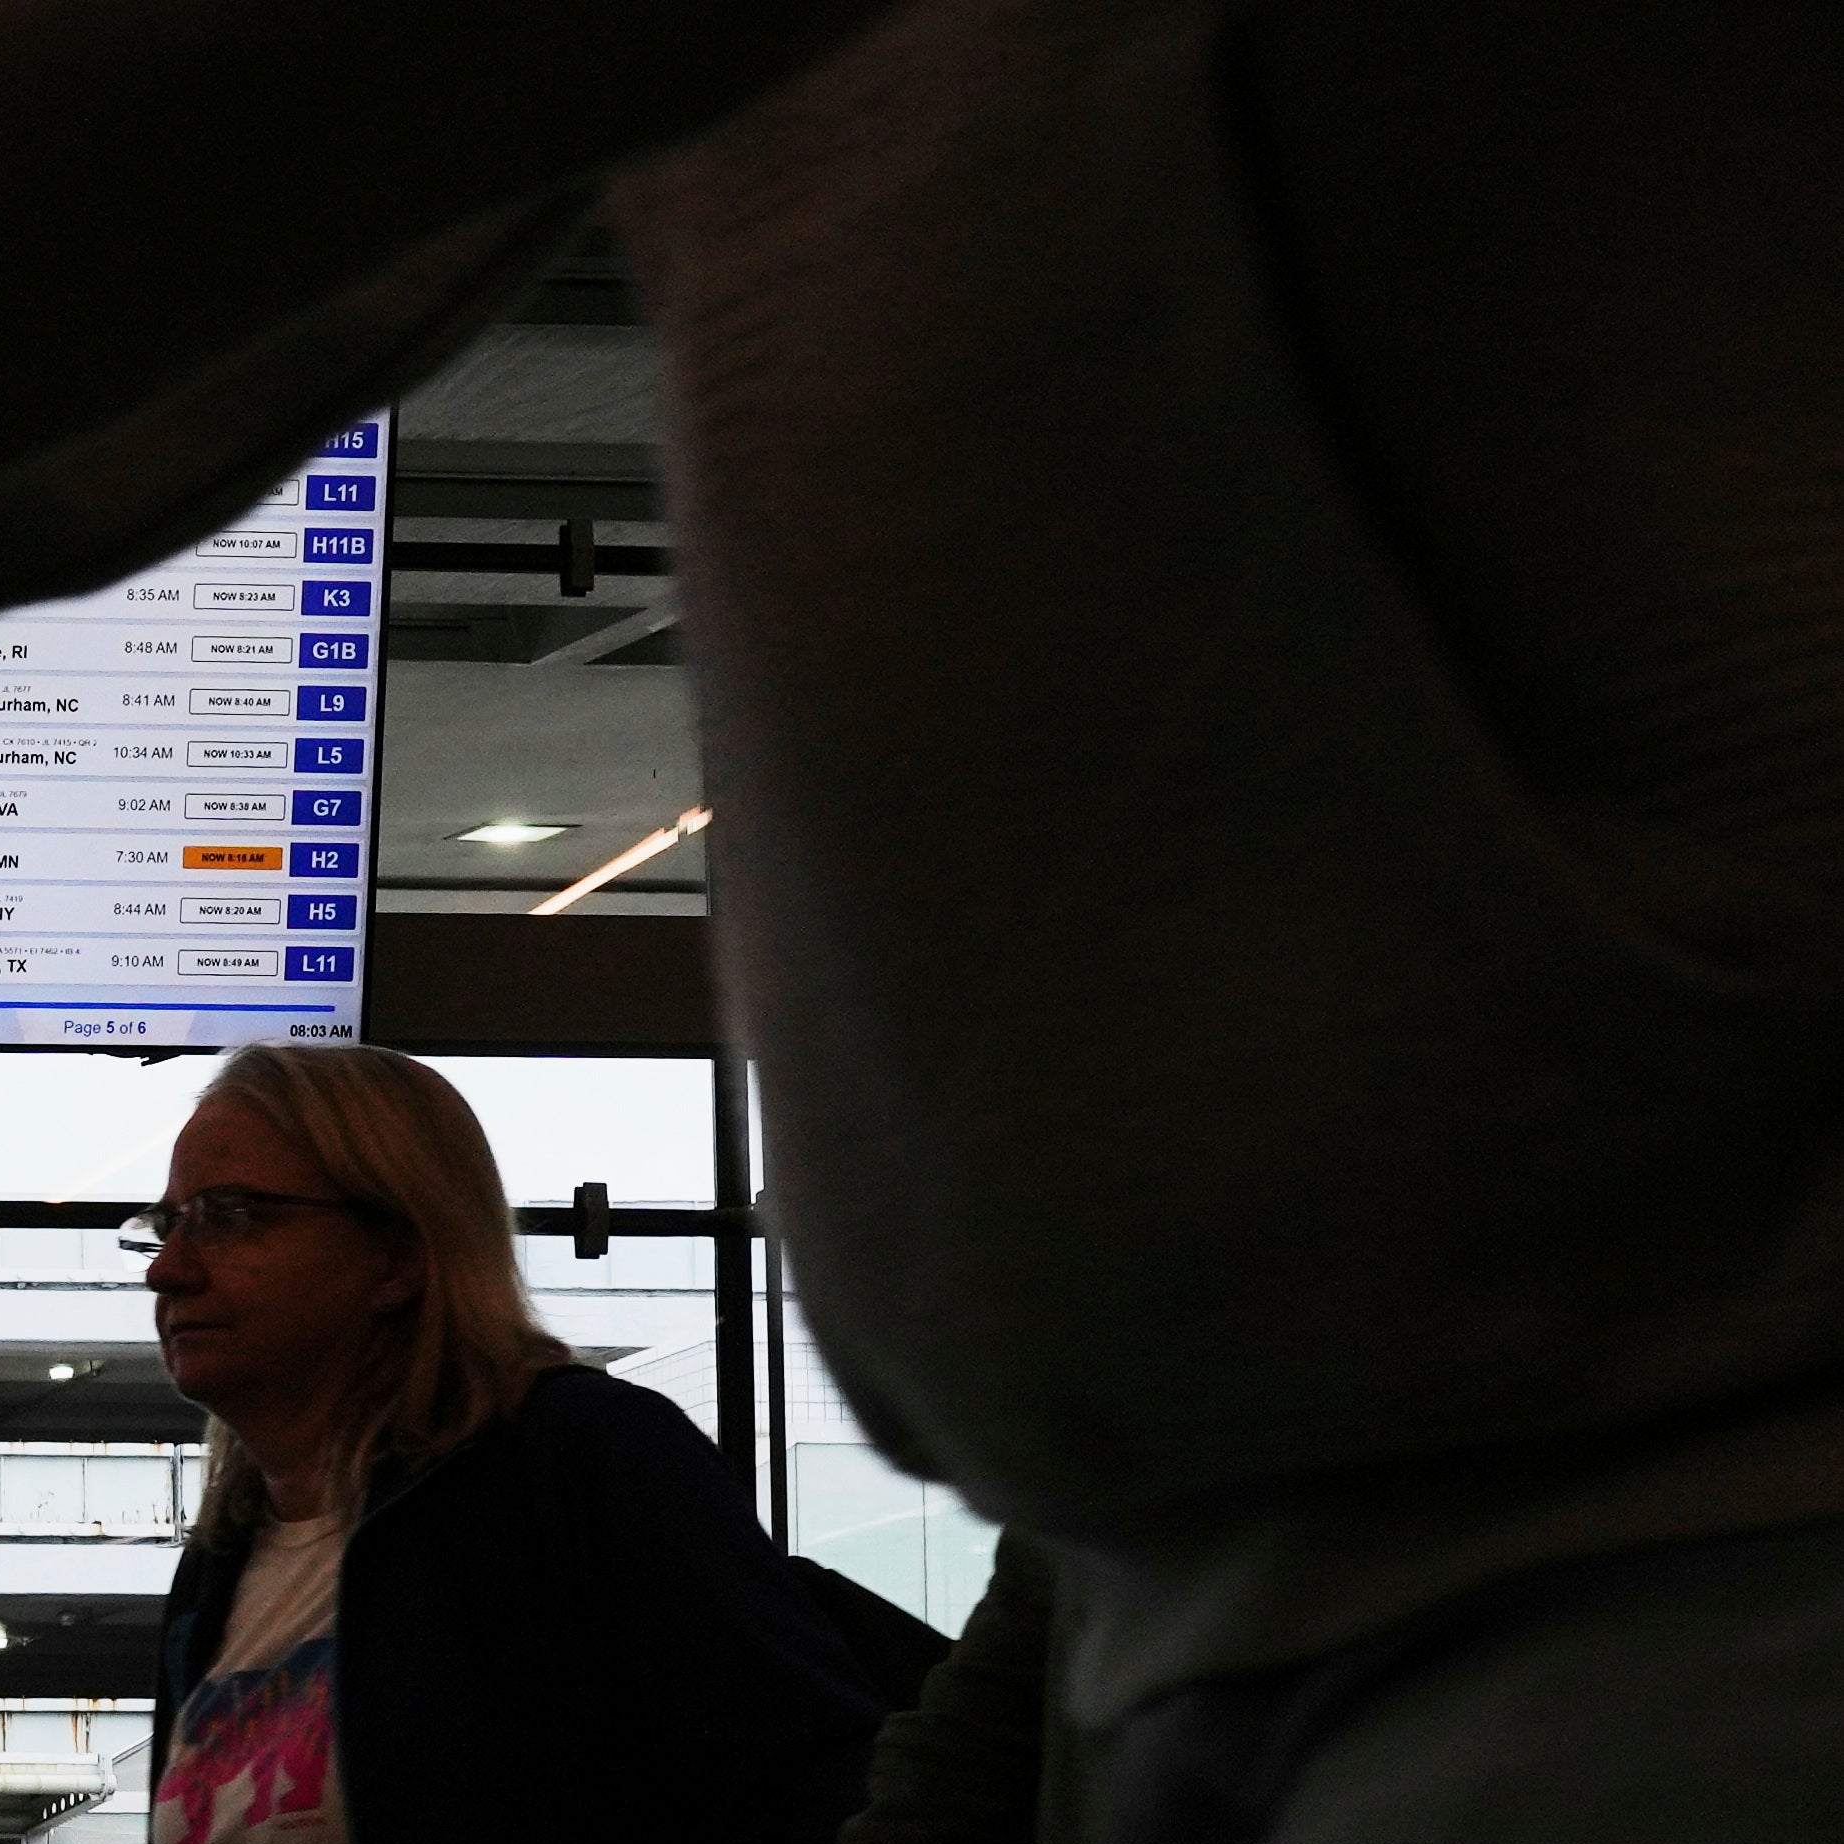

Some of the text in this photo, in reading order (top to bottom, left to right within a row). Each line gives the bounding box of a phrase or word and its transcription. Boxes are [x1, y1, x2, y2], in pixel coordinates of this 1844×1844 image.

[324, 484, 357, 501] L11
[212, 538, 237, 549] NOW
[266, 538, 281, 549] AM
[313, 537, 365, 554] H11B
[324, 589, 350, 606] K3
[12, 646, 27, 658] RI
[313, 642, 356, 659] G1B
[314, 799, 341, 816] G7
[312, 851, 338, 868] H2
[309, 903, 335, 920] H5
[7, 960, 26, 972] TX
[303, 955, 335, 972] L11
[65, 1021, 146, 1037] Page 5 of 6
